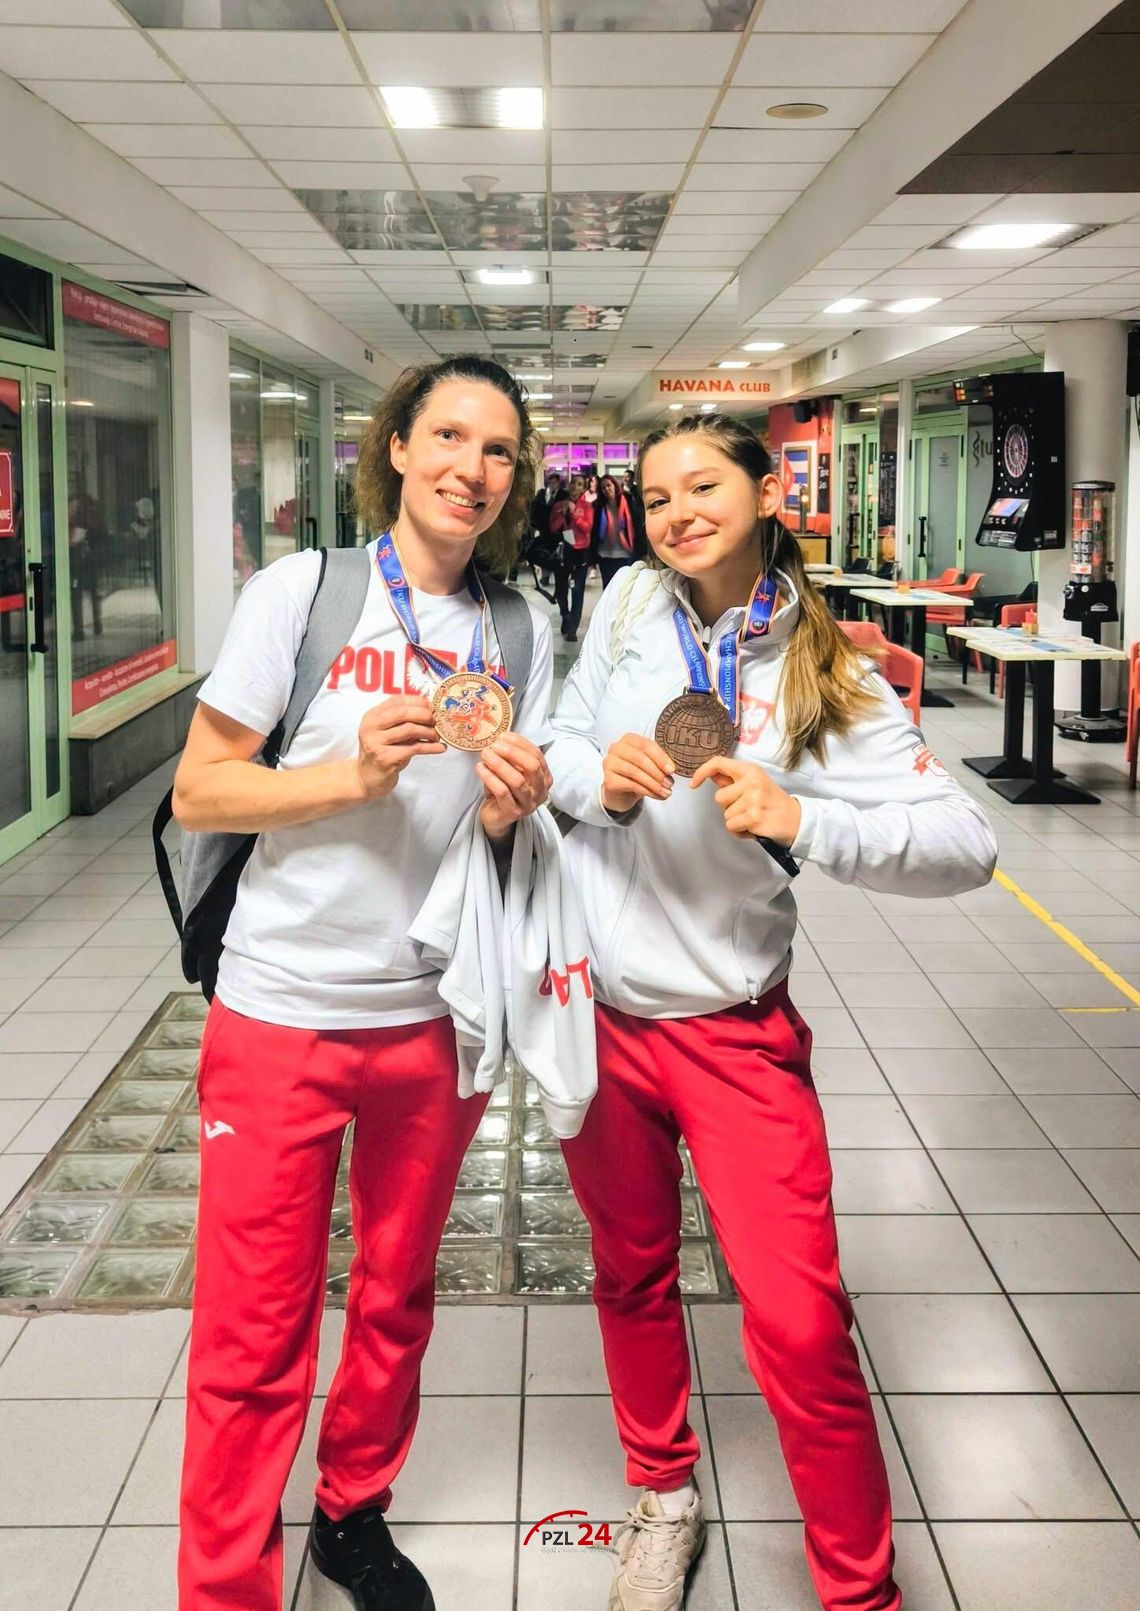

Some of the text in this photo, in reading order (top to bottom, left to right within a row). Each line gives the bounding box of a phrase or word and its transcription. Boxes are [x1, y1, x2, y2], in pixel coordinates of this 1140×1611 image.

[659, 379, 771, 393] HAVANA CLUB
[679, 626, 693, 651] WORLD
[723, 640, 733, 702] CHAMPIONSHIP
[667, 724, 720, 750] IKU
